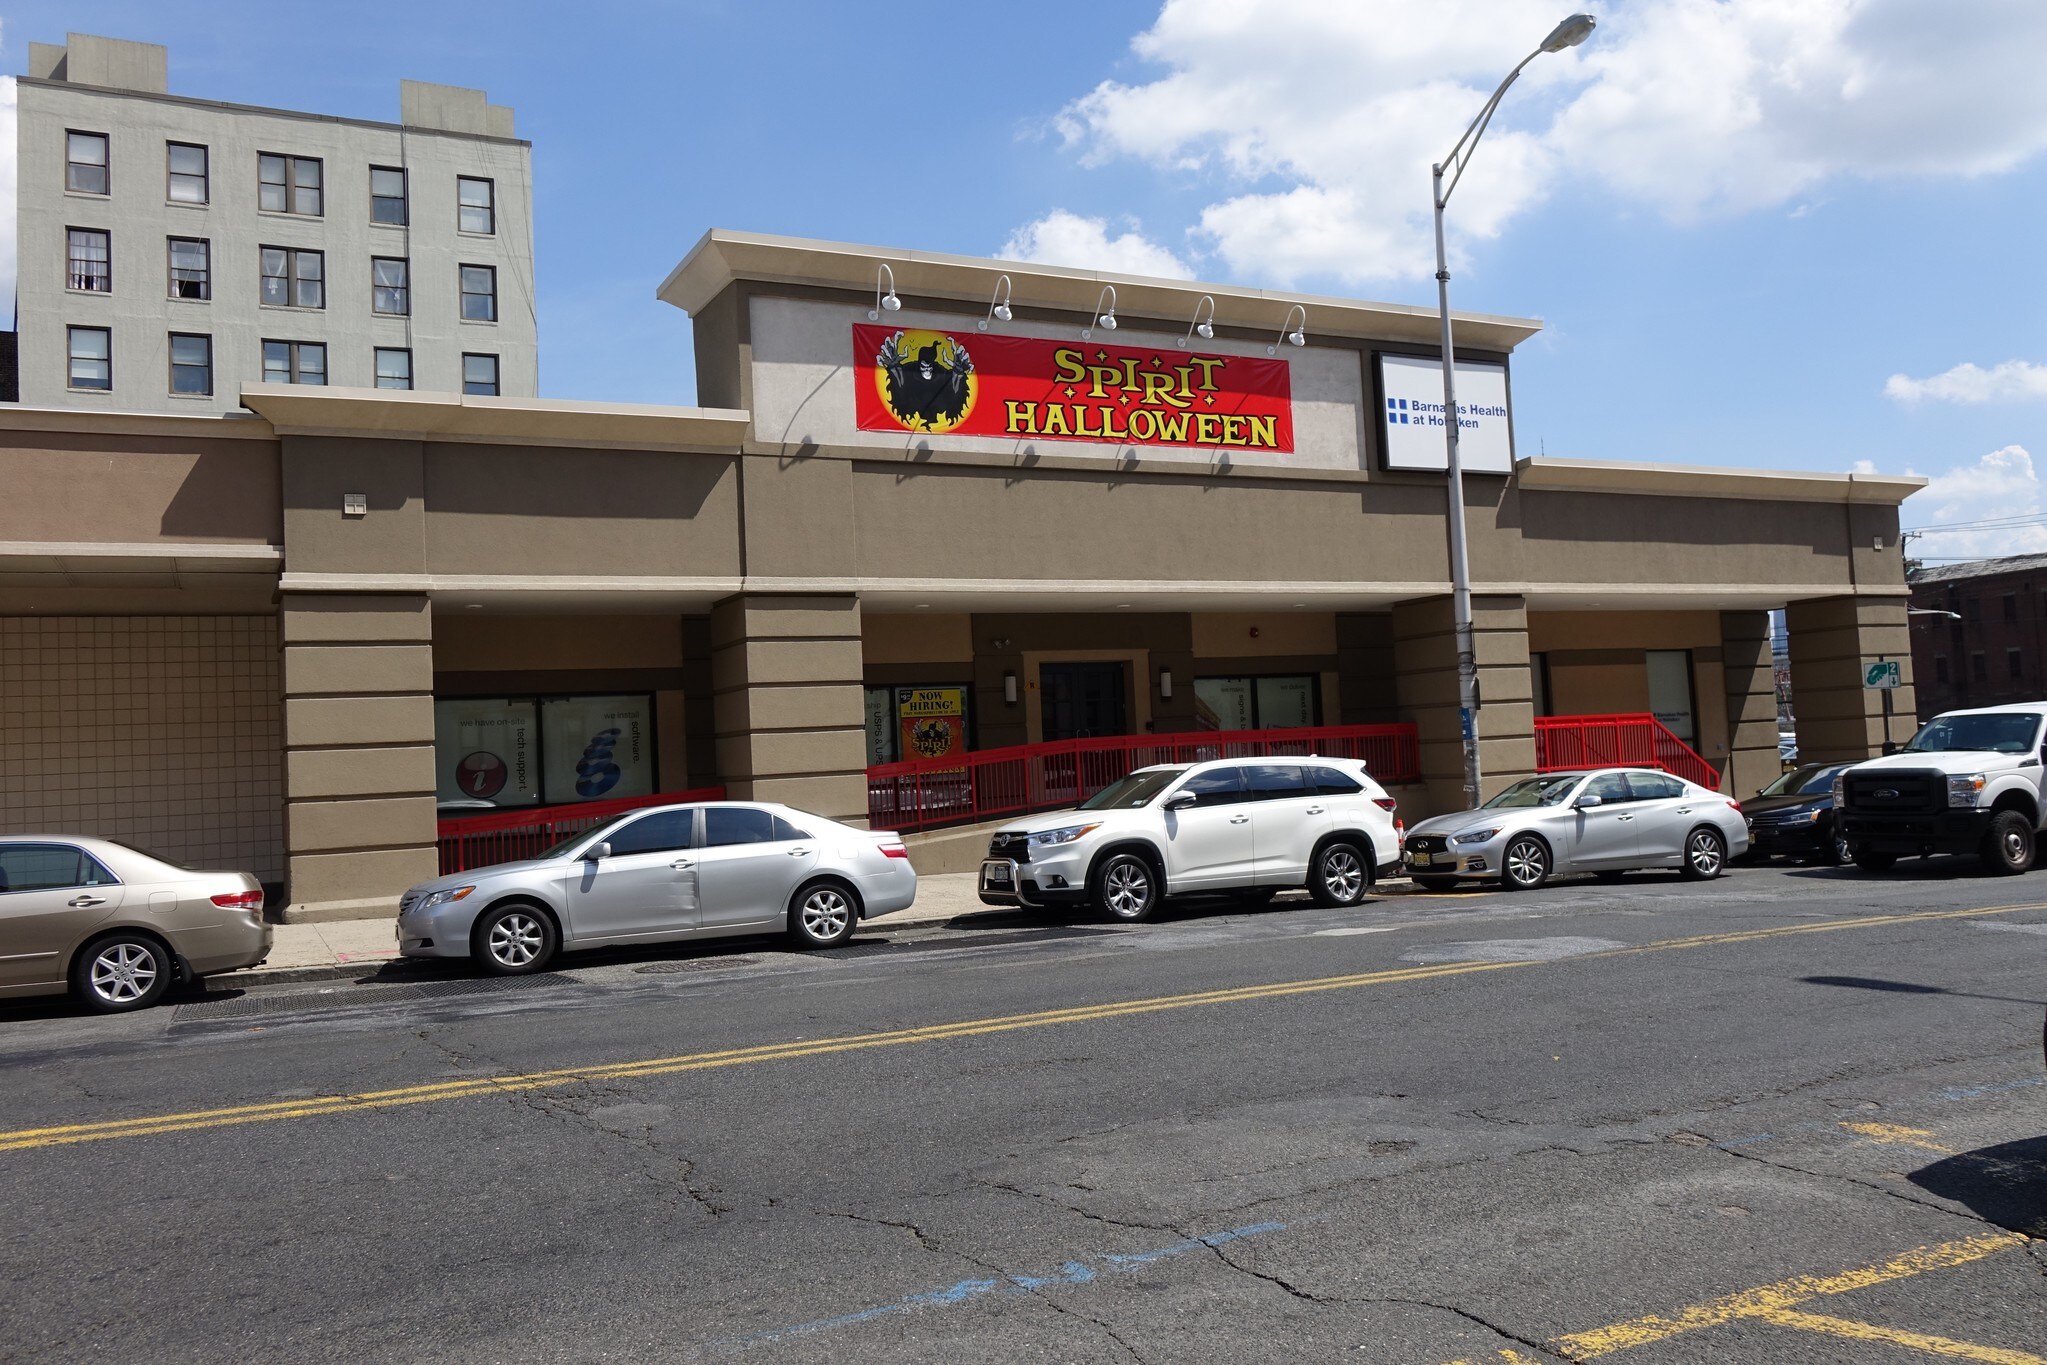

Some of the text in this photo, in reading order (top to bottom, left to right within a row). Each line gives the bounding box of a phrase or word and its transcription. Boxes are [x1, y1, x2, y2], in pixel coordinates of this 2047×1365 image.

[1054, 348, 1225, 408] SPIRIT
[1470, 404, 1506, 417] Health
[1005, 400, 1279, 448] HALLOWEEN
[1413, 415, 1479, 428] at Hoken
[1889, 663, 1897, 673] 2
[919, 691, 943, 701] NOW
[910, 701, 953, 711] HIRING!
[874, 712, 882, 736] USPS
[632, 721, 641, 764] software.
[912, 736, 953, 751] SPIRIT
[516, 727, 528, 792] tech support.
